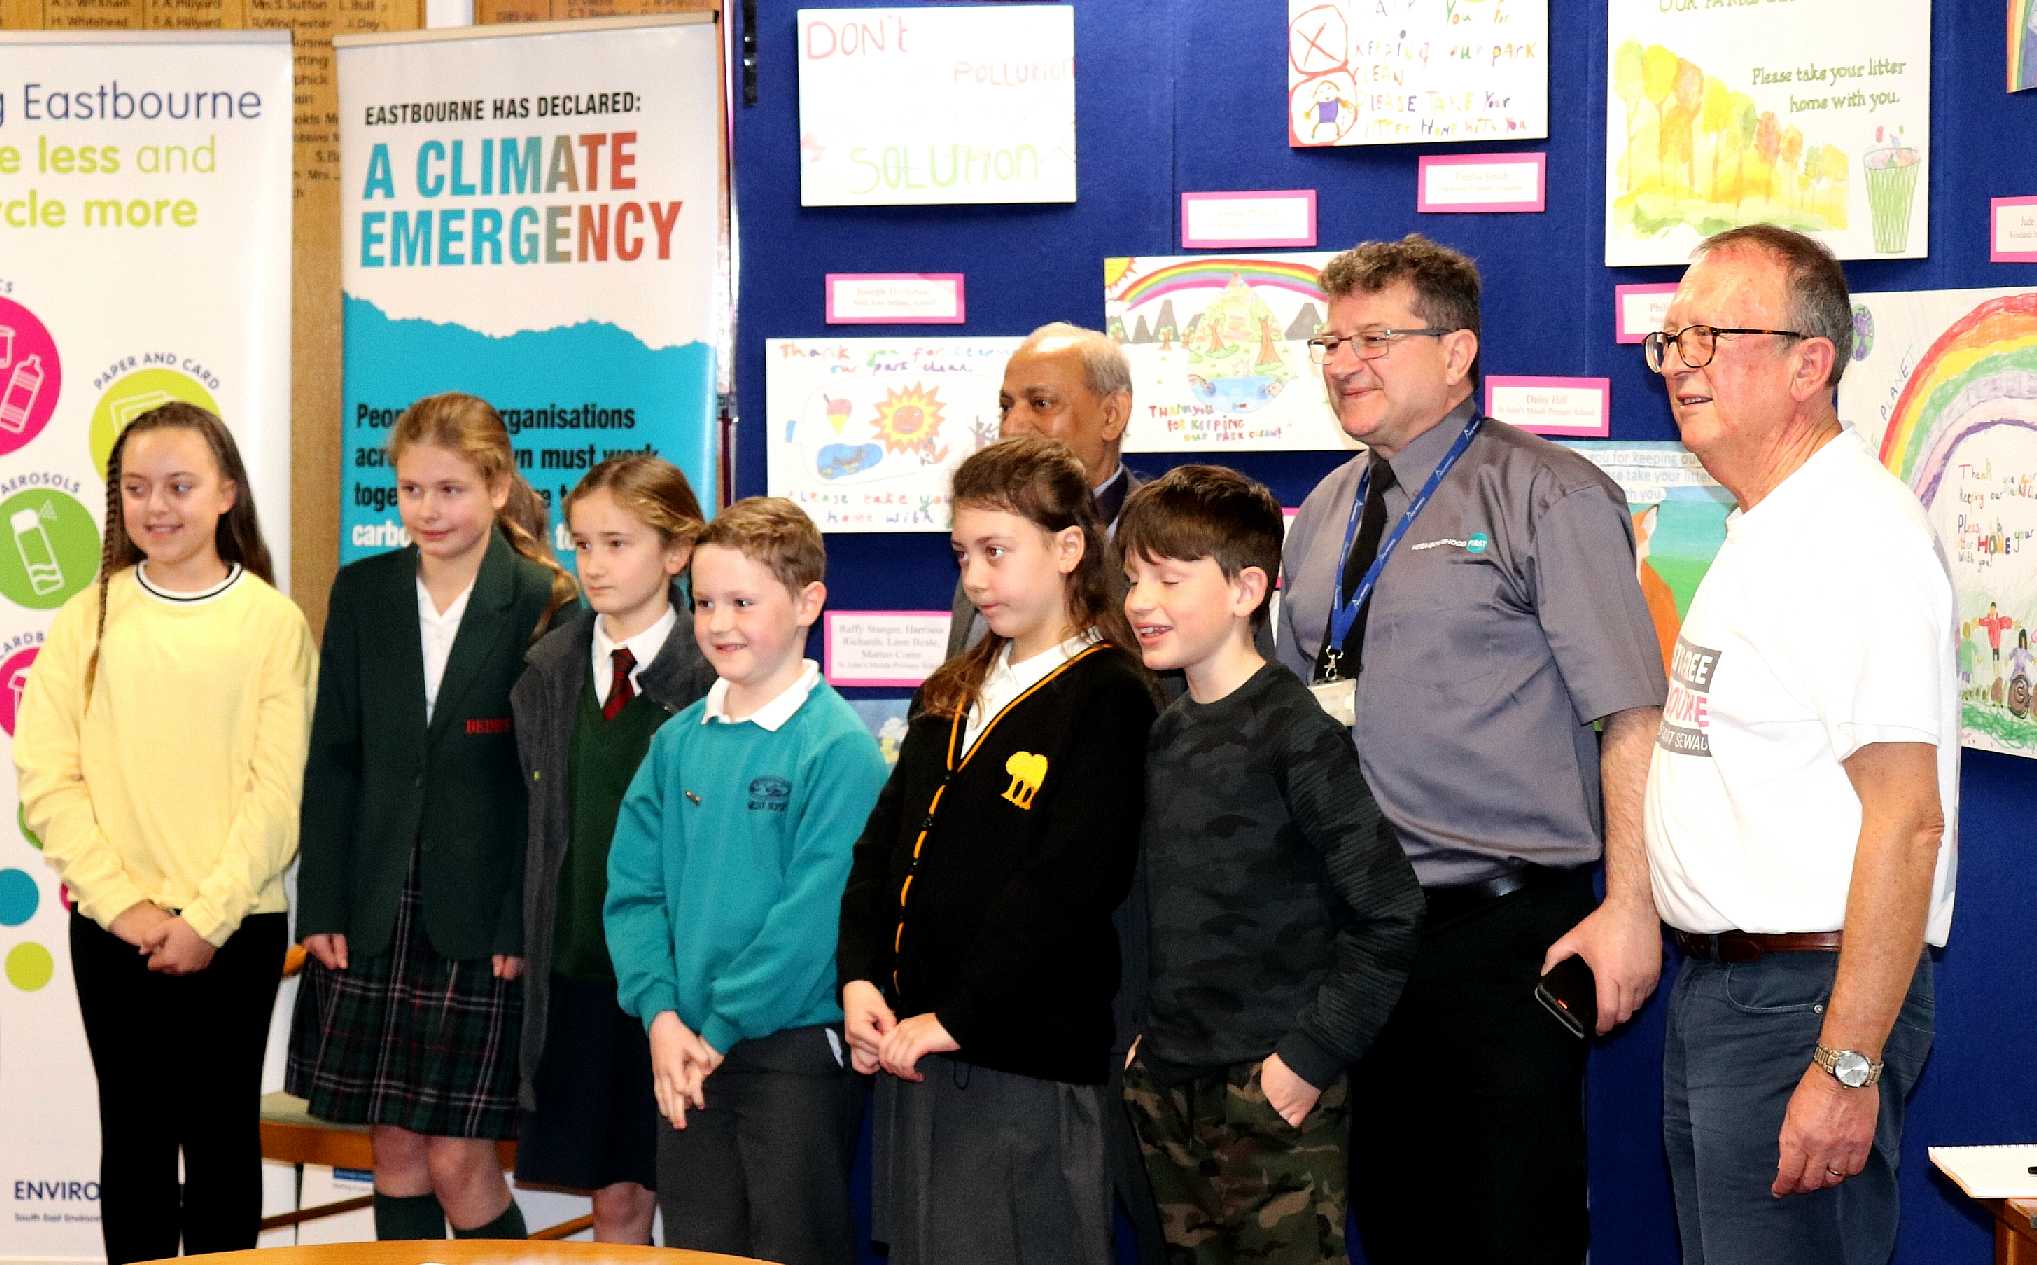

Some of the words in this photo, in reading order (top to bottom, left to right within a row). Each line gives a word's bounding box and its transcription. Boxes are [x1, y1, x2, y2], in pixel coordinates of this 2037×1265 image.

[1752, 66, 1793, 85] Please
[1796, 63, 1827, 82] take
[1829, 65, 1865, 87] your
[1867, 57, 1906, 76] litter
[24, 81, 263, 121] Eastbourne
[365, 100, 485, 126] EASTBOURNE
[493, 97, 530, 120] HAS
[538, 91, 641, 118] DECLARED:
[1790, 95, 1828, 113] home
[1831, 90, 1867, 110] with
[38, 135, 121, 174] less
[136, 134, 216, 174] and
[362, 143, 396, 200] A
[415, 131, 638, 199] CLIMATE
[84, 198, 198, 228] more
[360, 201, 684, 269] EMERGENCY
[94, 355, 137, 392] PAPER
[142, 352, 177, 366] AND
[182, 358, 220, 391] CARD
[541, 443, 595, 469] must
[1, 472, 81, 495] AEROSOLS
[15, 1181, 101, 1201] ENVIRO
